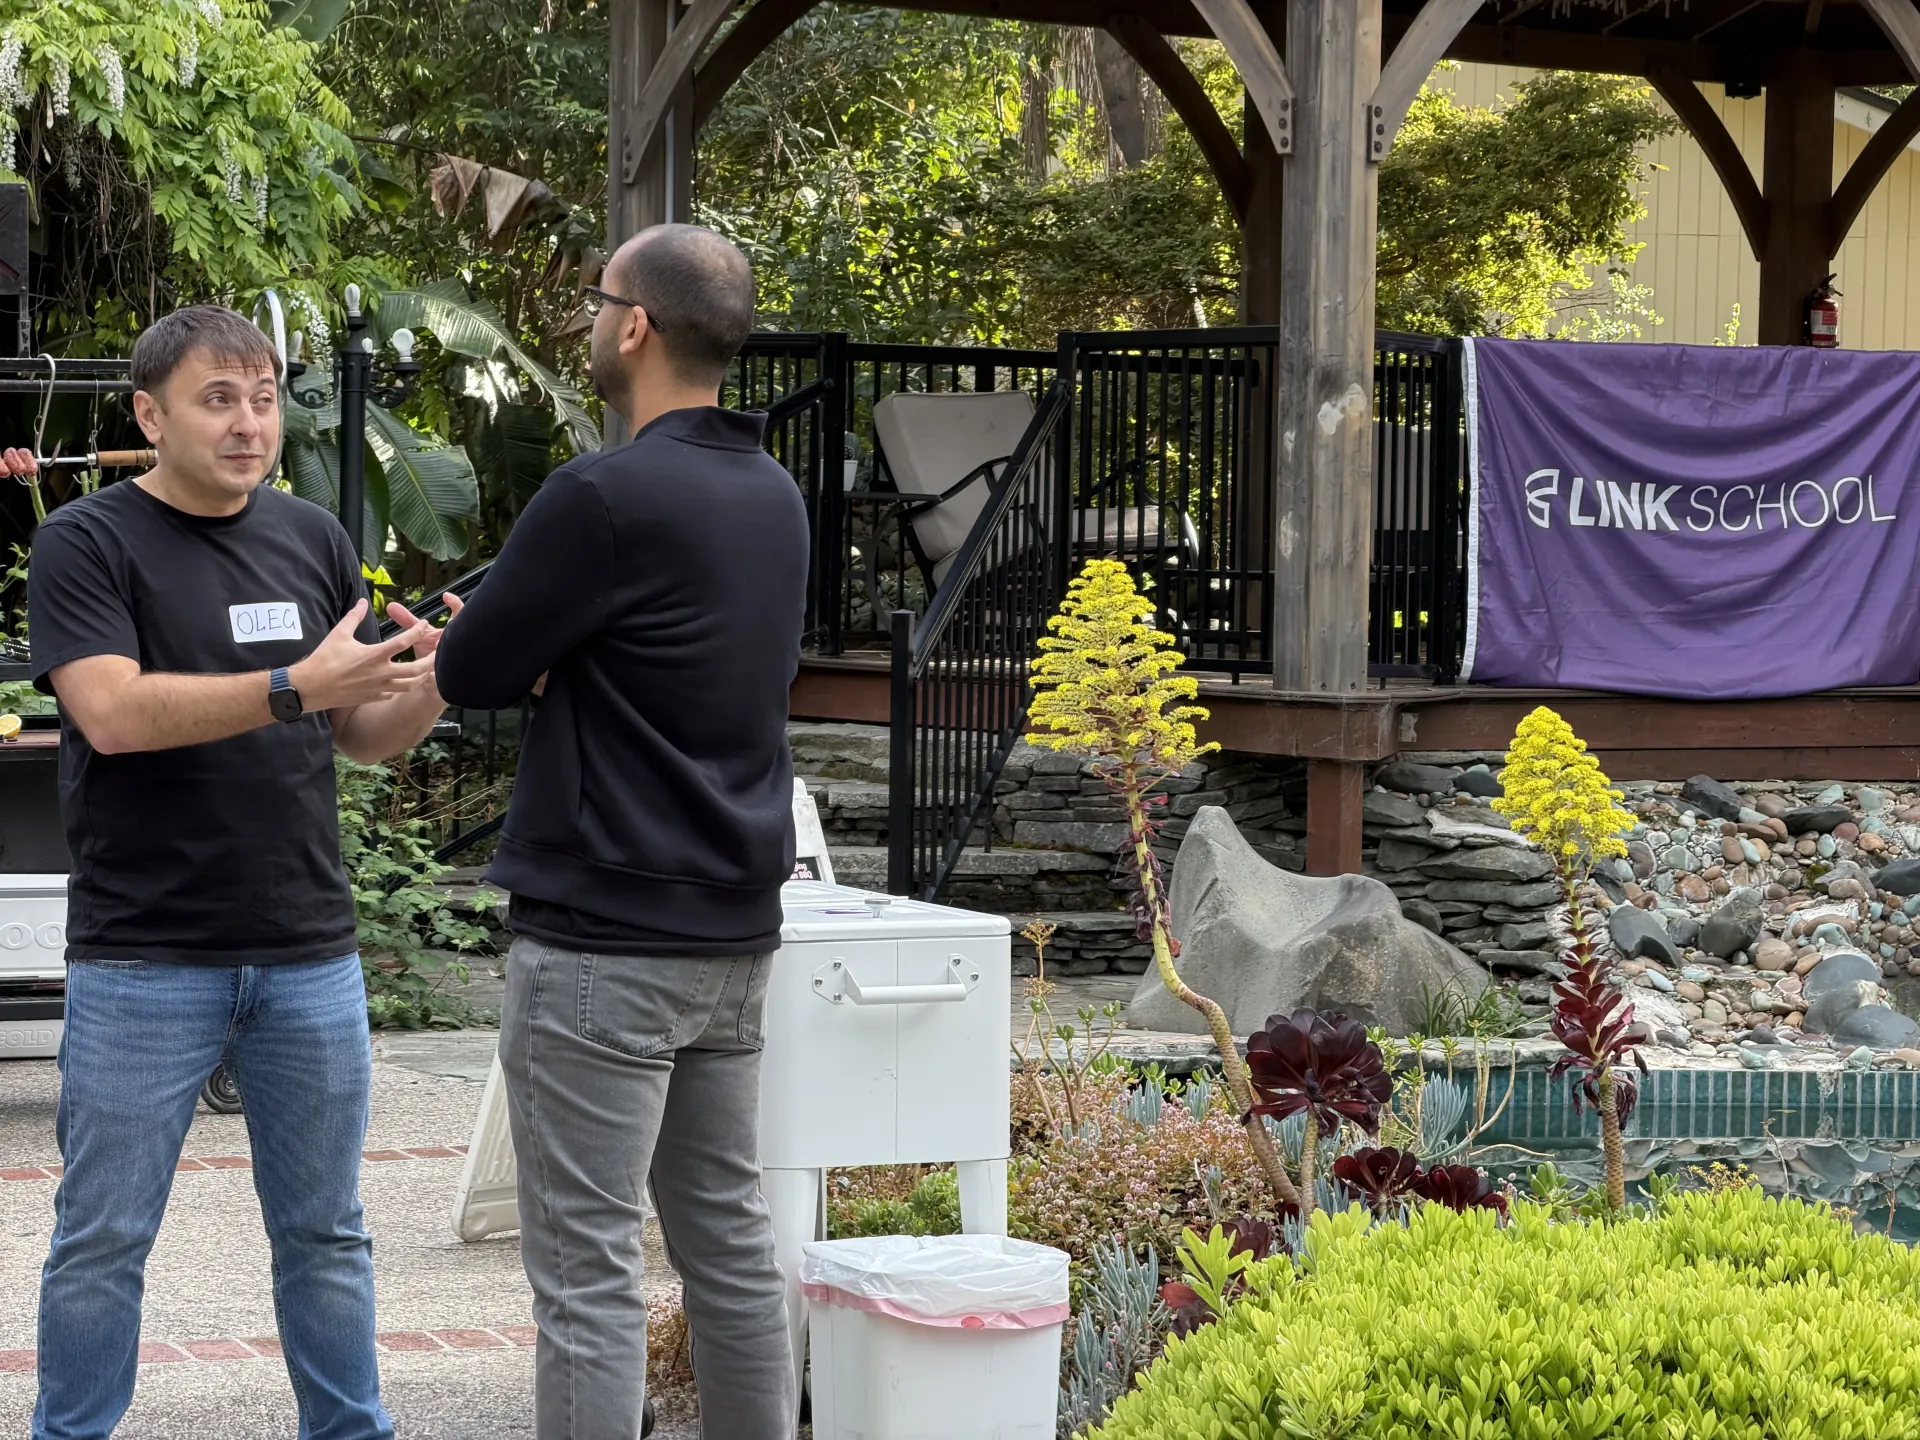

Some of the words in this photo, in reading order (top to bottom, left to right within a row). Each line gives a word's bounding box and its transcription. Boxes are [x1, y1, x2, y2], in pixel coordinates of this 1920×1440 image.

[1570, 477, 1683, 531] LINK
[1686, 474, 1897, 532] SCHOOL
[236, 608, 296, 635] OLEG
